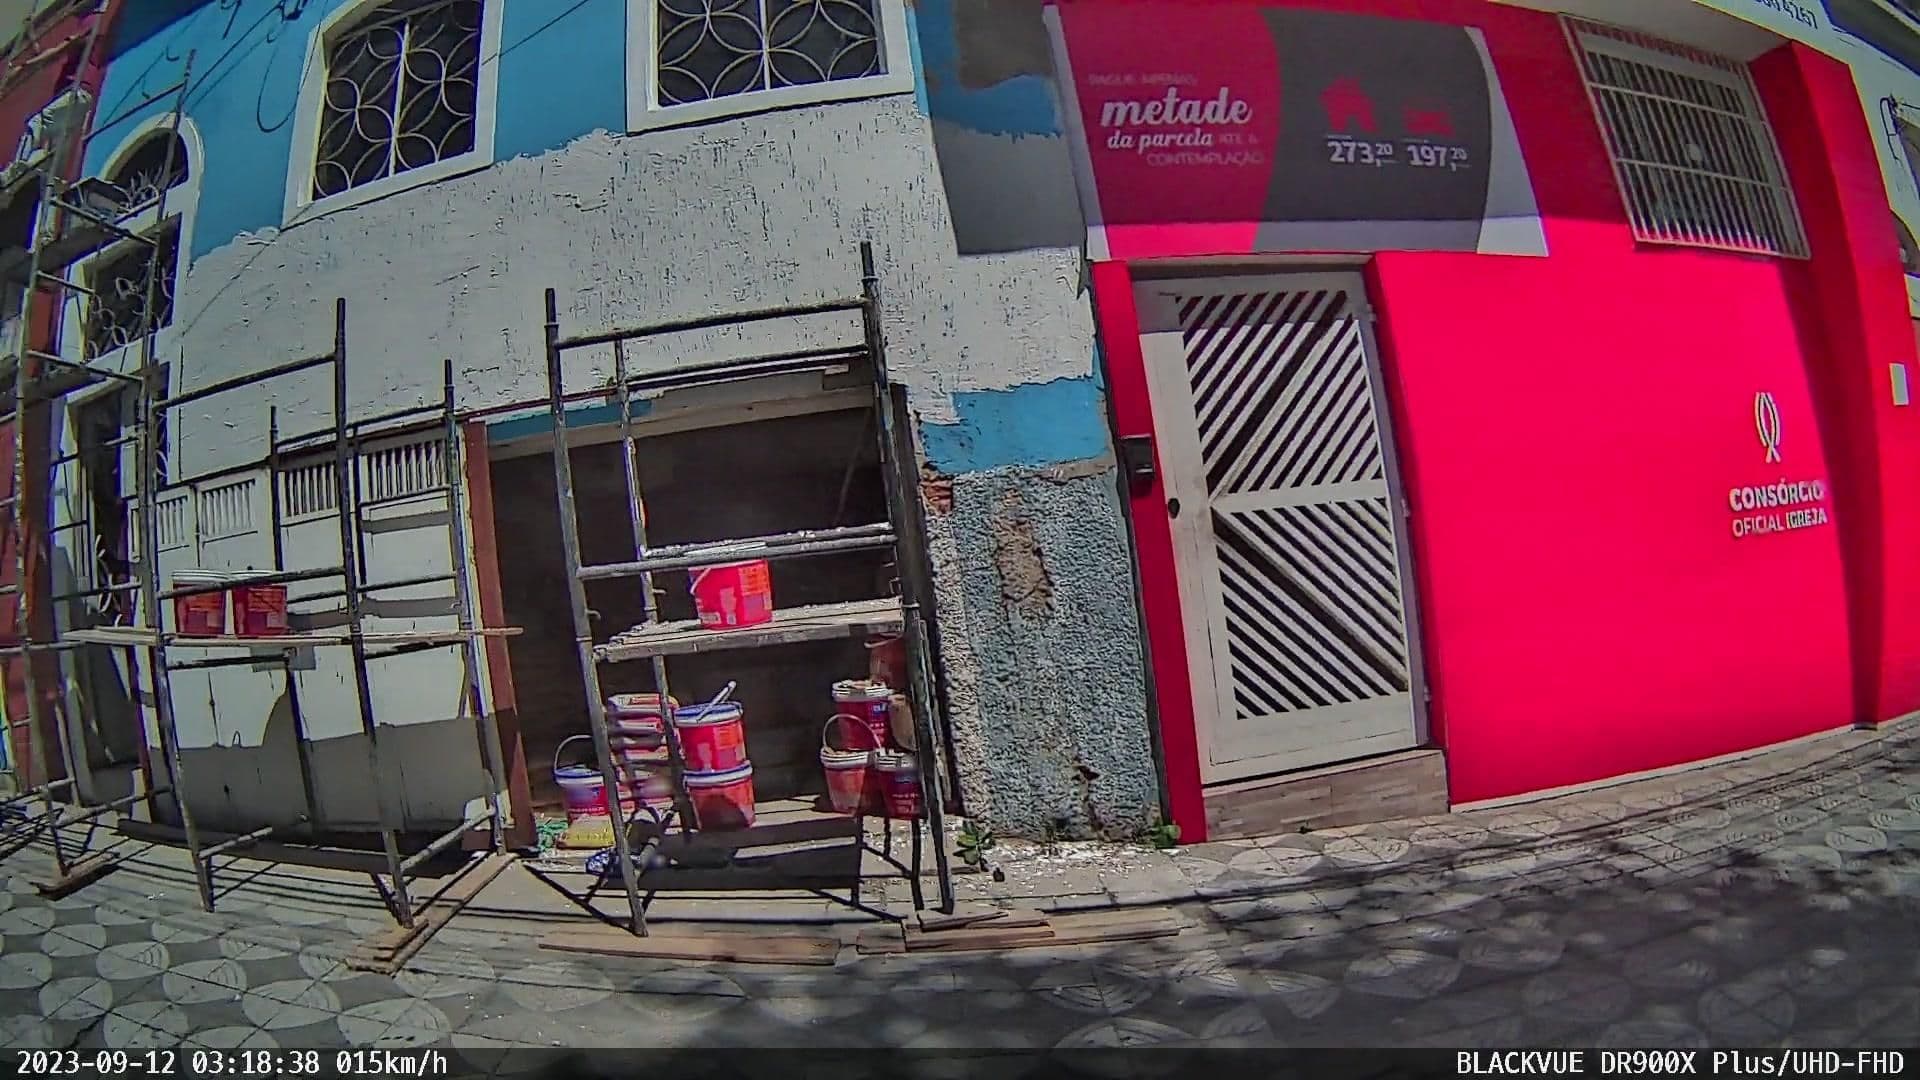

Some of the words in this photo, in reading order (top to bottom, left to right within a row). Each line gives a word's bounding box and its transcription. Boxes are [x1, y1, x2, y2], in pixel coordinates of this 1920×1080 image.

[1101, 86, 1253, 127] metade
[1107, 129, 1134, 149] da
[1138, 127, 1213, 155] parcela
[1729, 477, 1826, 512] CONSÓRCIO
[1732, 514, 1785, 537] OFICIAL
[1785, 507, 1828, 530] IGREJA
